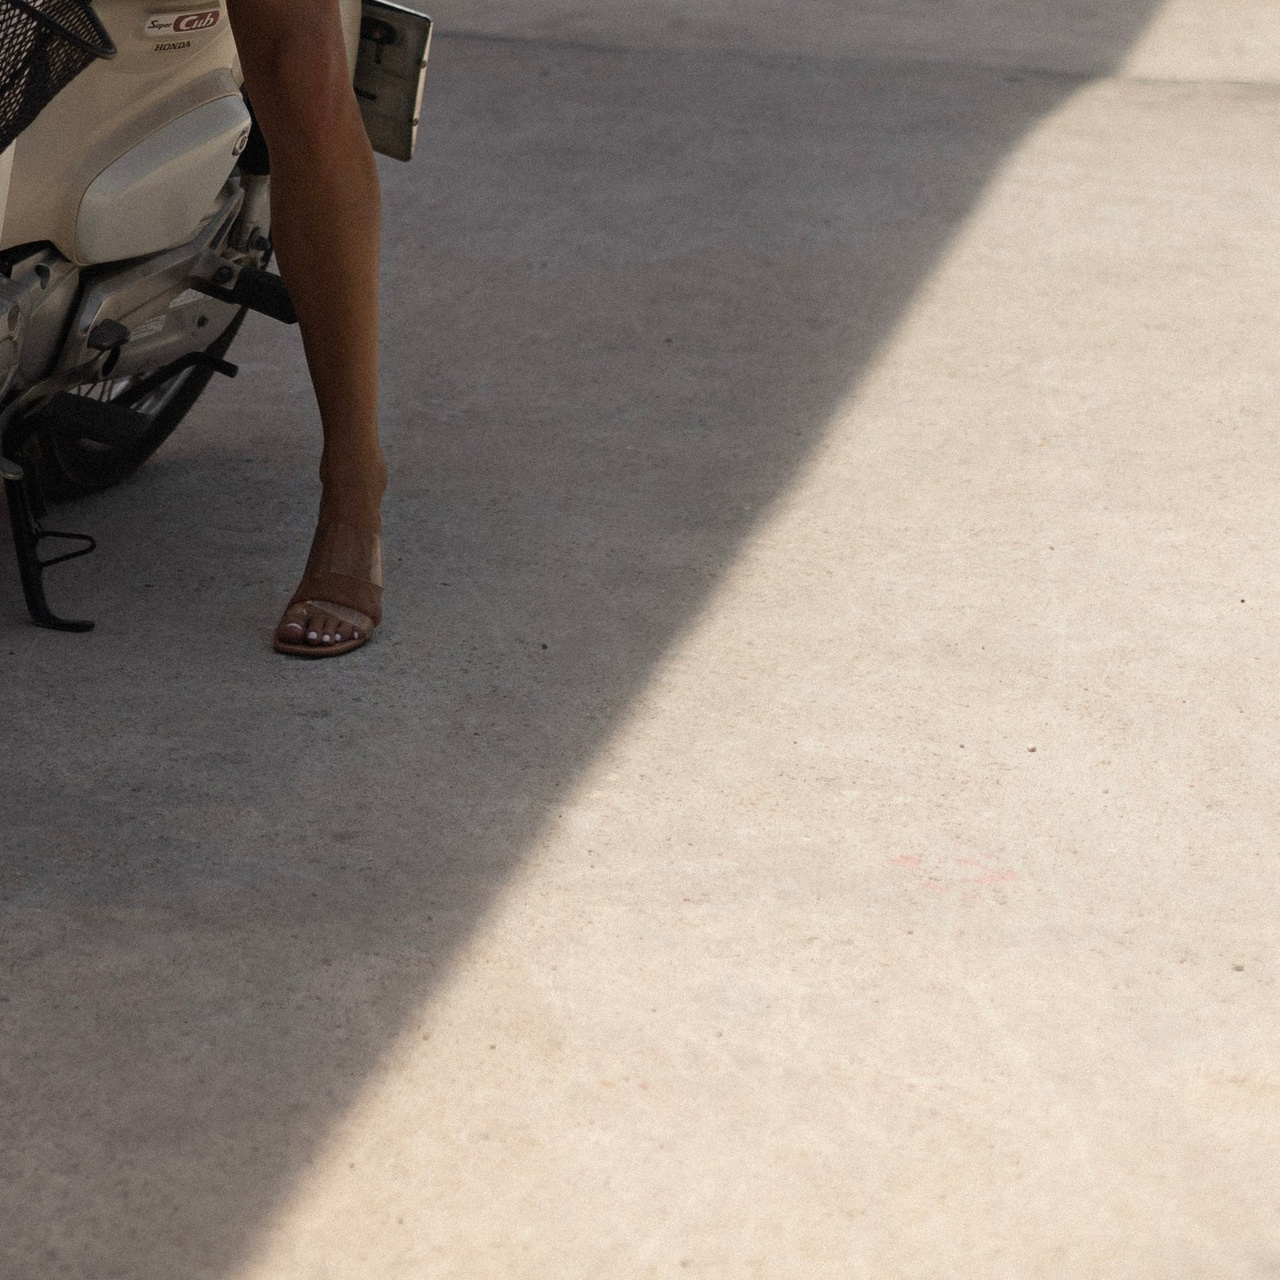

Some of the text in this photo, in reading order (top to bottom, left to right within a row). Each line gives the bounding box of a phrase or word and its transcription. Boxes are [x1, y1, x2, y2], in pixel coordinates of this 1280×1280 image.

[147, 13, 214, 31] Super Cub
[153, 41, 190, 51] HONDA
